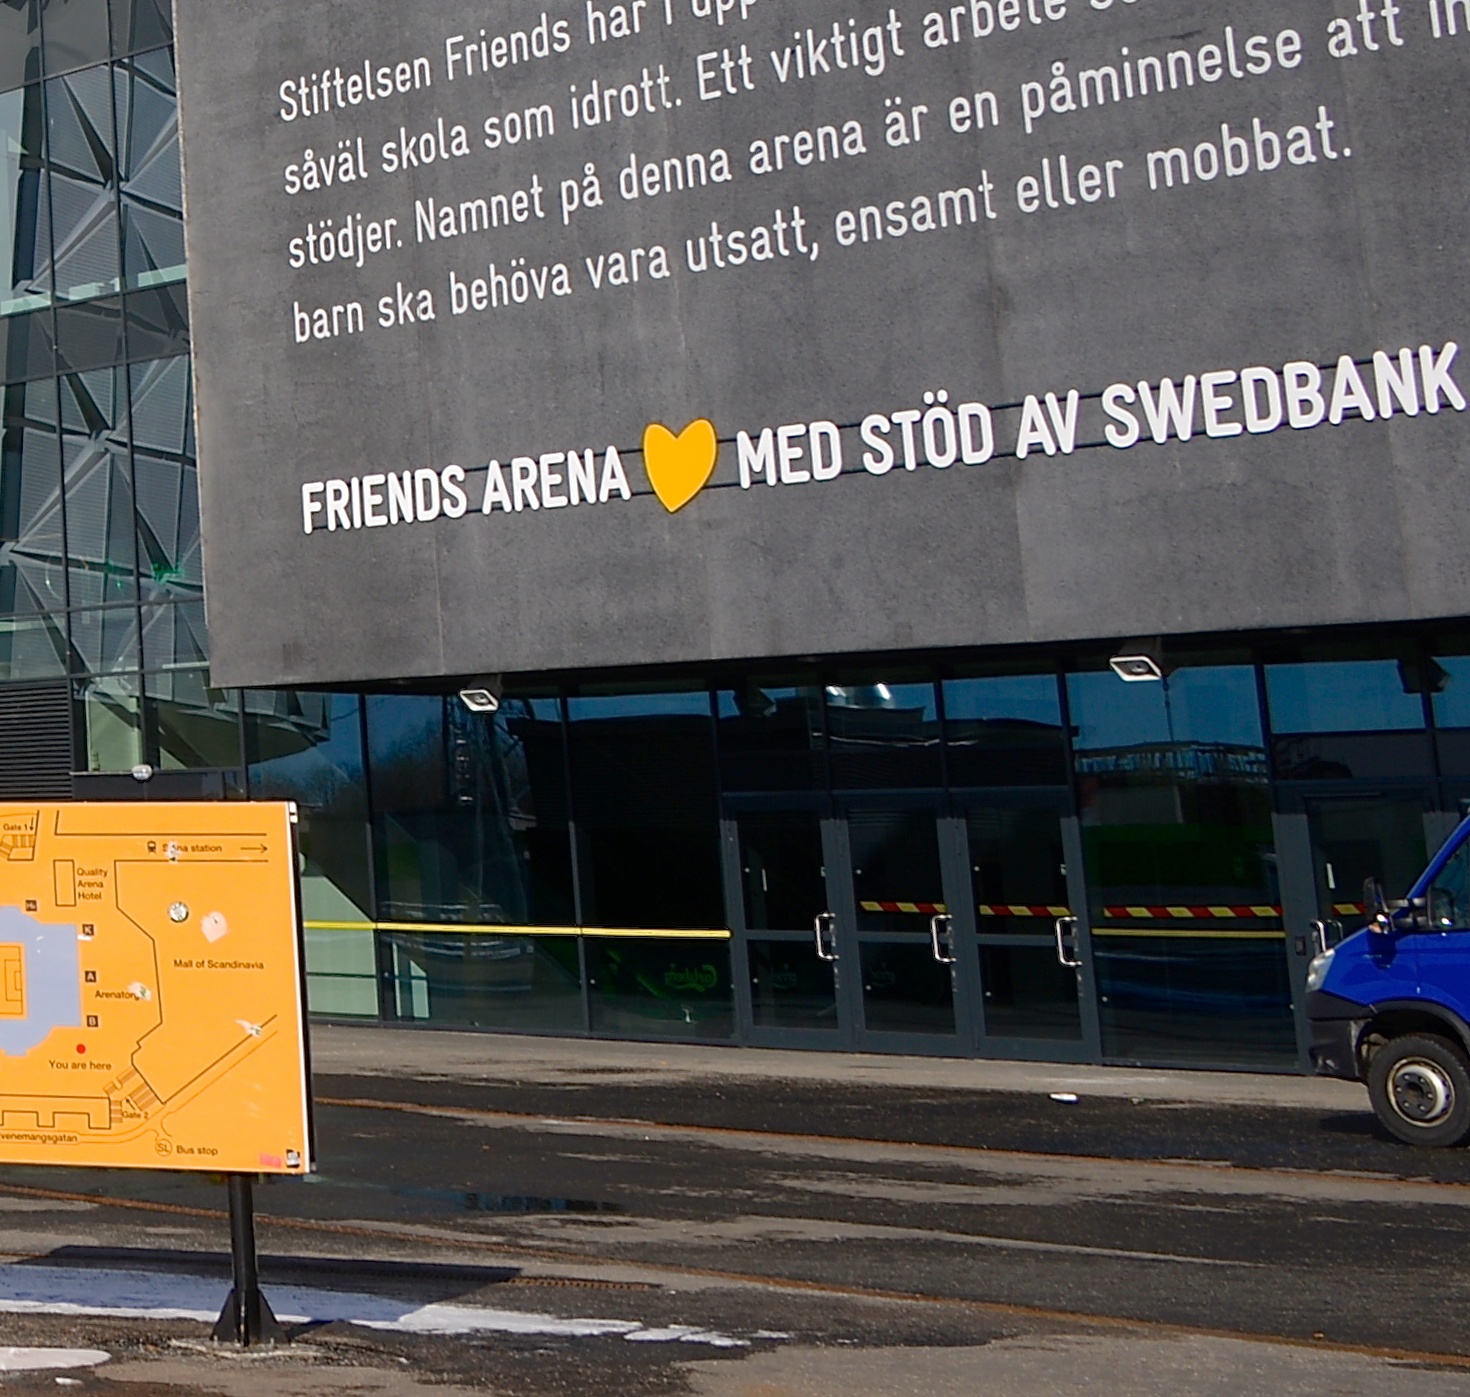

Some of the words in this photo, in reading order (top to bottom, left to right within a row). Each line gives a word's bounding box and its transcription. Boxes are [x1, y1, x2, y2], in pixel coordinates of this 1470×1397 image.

[279, 57, 431, 122] Stiftelsen
[445, 12, 571, 81] Friends
[586, 0, 647, 45] har
[284, 136, 368, 195] såväl
[381, 117, 470, 173] skola
[484, 104, 555, 149] som
[570, 64, 682, 130] idrott.
[696, 44, 755, 101] Ett
[770, 8, 905, 83] viktigt
[289, 214, 403, 268] stödjer.
[415, 174, 545, 243] Namnet
[560, 162, 604, 226] på
[619, 148, 733, 200] denna
[749, 120, 867, 174] arena
[884, 96, 928, 147] är
[949, 91, 999, 133] en
[1021, 25, 1302, 134] påminnelse
[293, 301, 364, 343] barn
[378, 281, 436, 328] ska
[449, 259, 572, 315] behöva
[585, 245, 671, 289] vara
[686, 205, 819, 272] utsatt,
[835, 169, 997, 246] ensamt
[1016, 154, 1124, 213] eller
[1146, 105, 1351, 190] mobbat.
[301, 464, 468, 534] FRIENDS
[482, 445, 631, 515] ARENA
[736, 420, 843, 489] MED
[860, 402, 994, 475] STÖD
[1016, 389, 1079, 459] AV
[1101, 341, 1467, 448] SWEDBANK
[3, 823, 21, 831] Gate
[190, 843, 222, 852] station
[77, 867, 108, 877] Quality
[77, 879, 104, 888] Arena
[77, 891, 102, 900] Hotel
[173, 959, 193, 968] Mall
[195, 960, 205, 968] of
[207, 959, 264, 969] Scandinavia
[49, 1060, 69, 1069] You
[71, 1062, 87, 1070] are
[89, 1061, 112, 1070] here
[122, 1111, 141, 1119] Gate
[176, 1145, 195, 1154] Bus
[197, 1146, 218, 1156] stop
